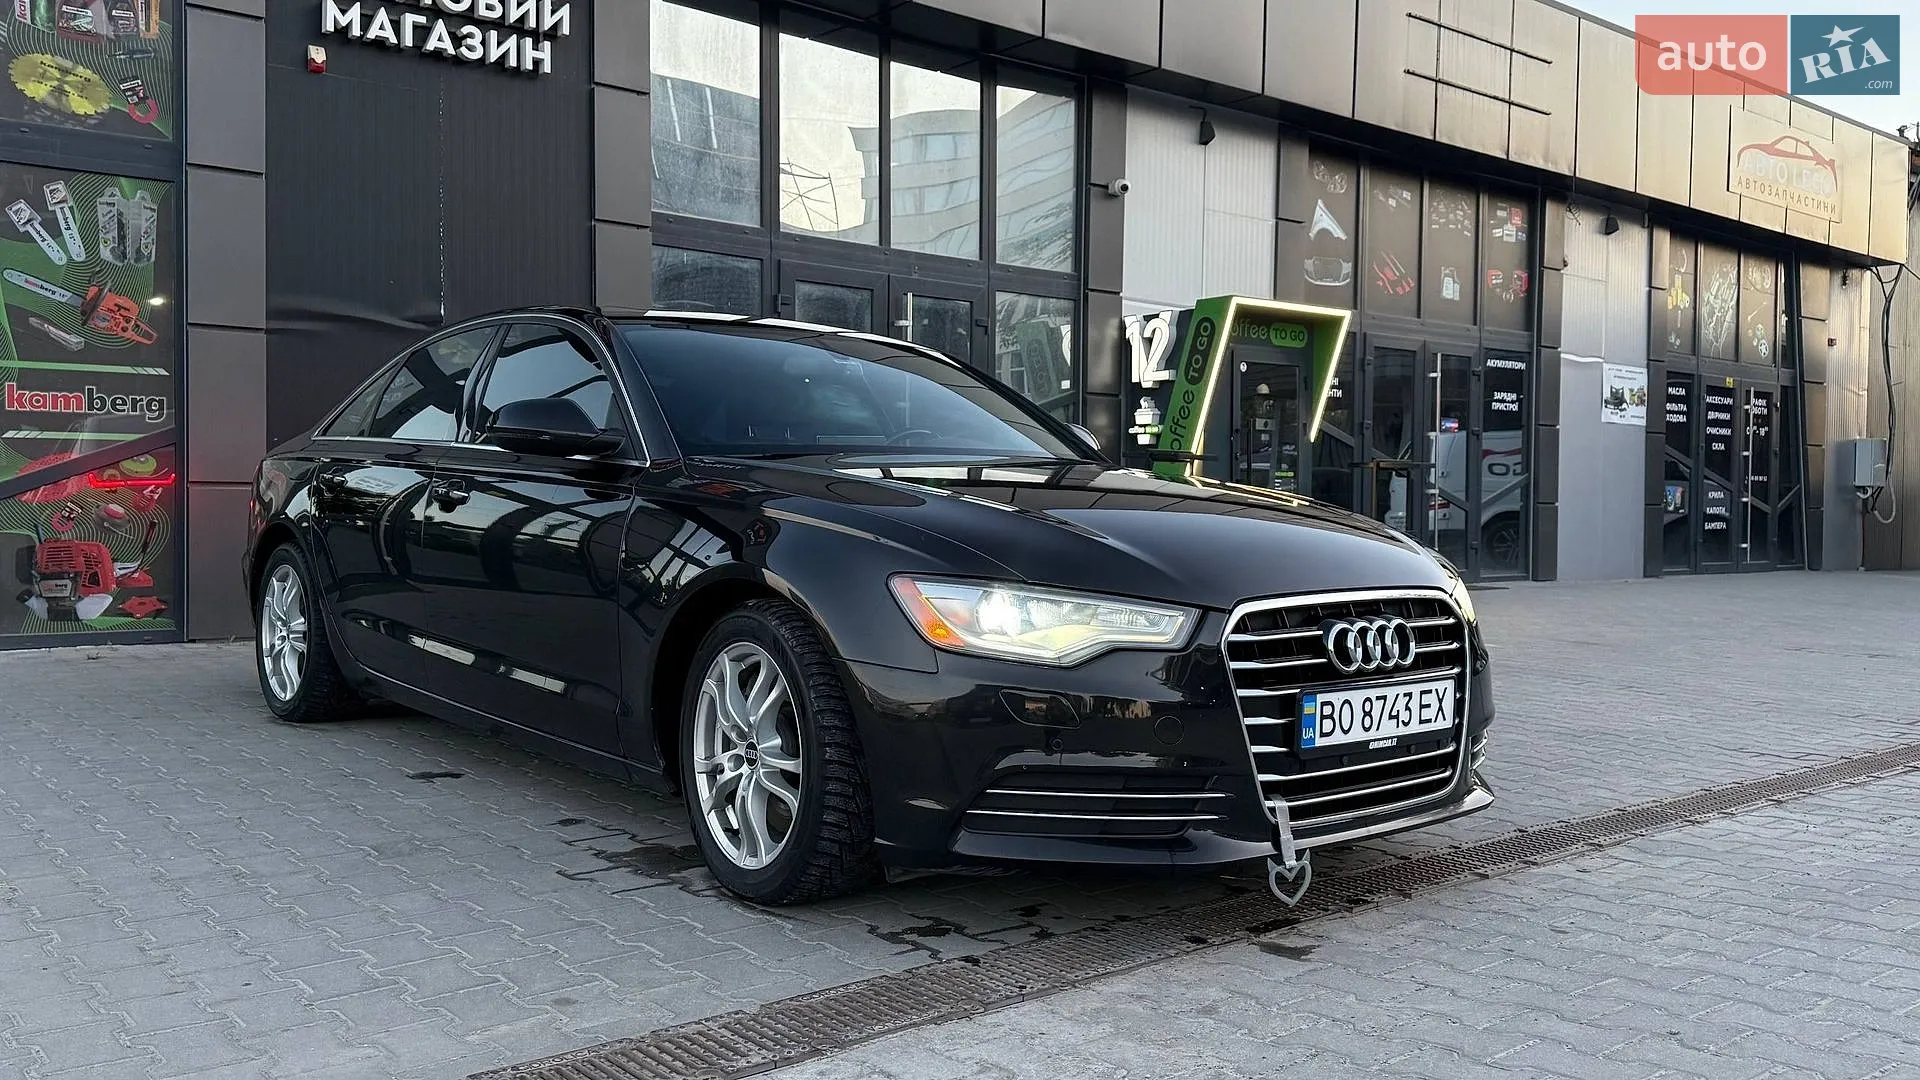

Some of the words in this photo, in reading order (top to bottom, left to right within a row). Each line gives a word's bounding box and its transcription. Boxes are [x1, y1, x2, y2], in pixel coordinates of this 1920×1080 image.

[322, 0, 551, 74] МАГАЗИН
[1737, 175, 1836, 215] АВТОЗАПЧАСТИНИ
[1231, 317, 1269, 339] offee
[1272, 327, 1288, 340] TO
[1289, 329, 1306, 342] GO
[1486, 358, 1526, 370] АКУМУЛЯТОРИ
[1170, 388, 1196, 451] offee
[1187, 356, 1203, 382] TO
[1196, 321, 1211, 351] GO
[1667, 386, 1686, 396] МАСЛА
[5, 383, 167, 422] kamberg
[1493, 391, 1517, 402] ЗАРЯДНІ
[1706, 396, 1733, 405] АКСЕСУАРИ
[1491, 401, 1519, 411] ПРИСТРОЇ
[1665, 413, 1687, 423] ХОДОВА
[1706, 426, 1732, 436] ОЧИСНИКИ
[1712, 442, 1726, 451] СКЛА
[1361, 691, 1414, 733] 8743
[1418, 686, 1449, 725] EX
[1302, 727, 1315, 740] UA
